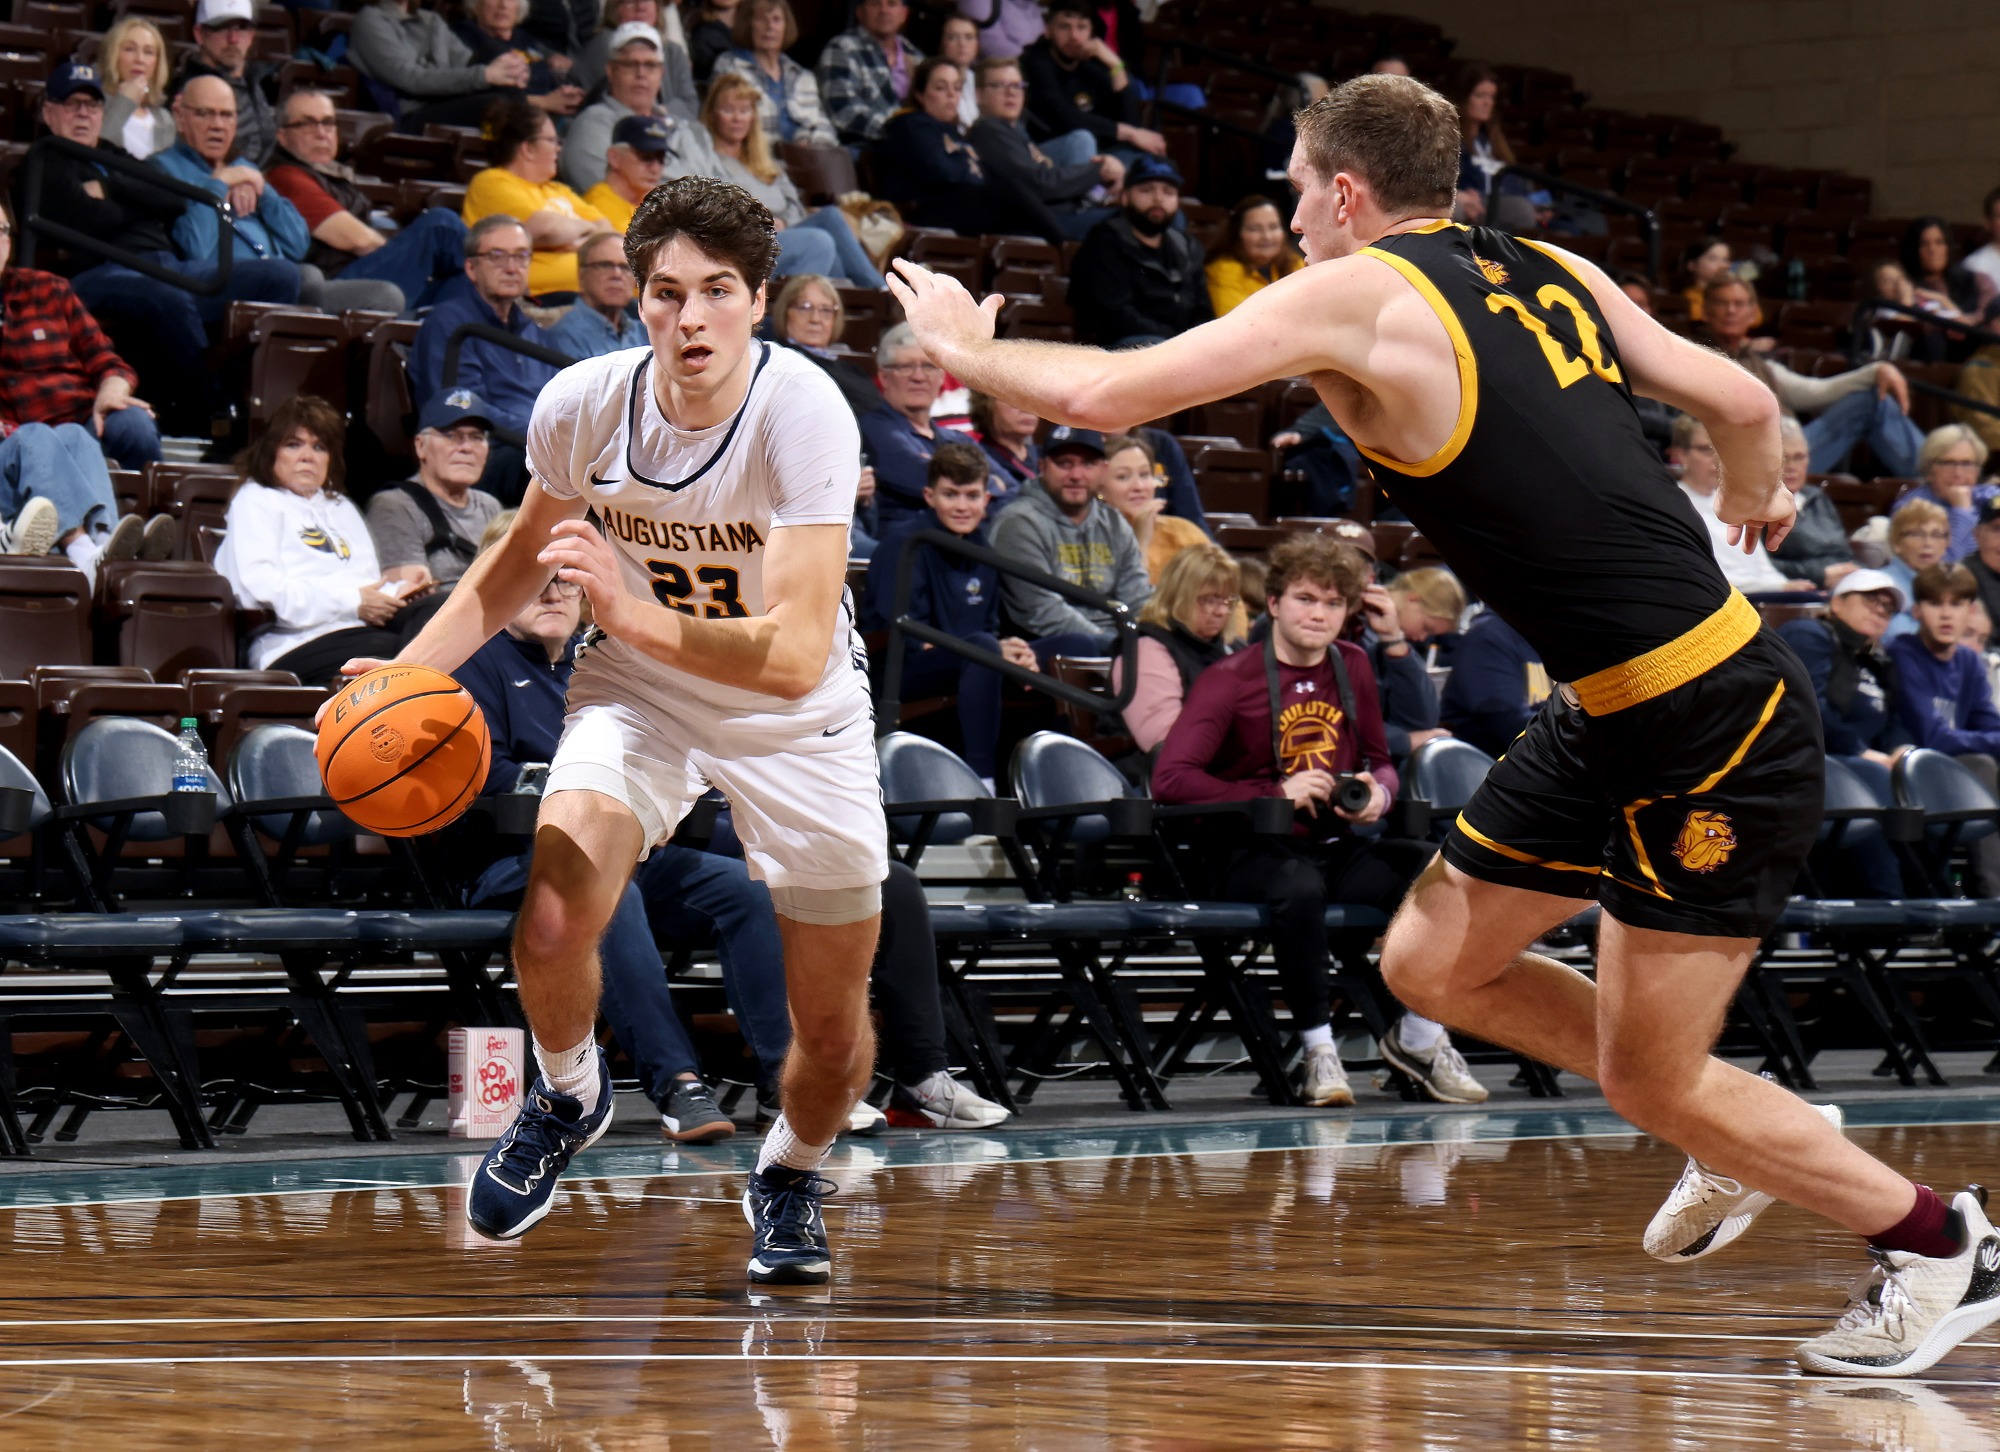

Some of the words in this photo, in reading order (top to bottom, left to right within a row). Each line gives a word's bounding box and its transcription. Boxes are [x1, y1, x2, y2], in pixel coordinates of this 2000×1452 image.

[1485, 284, 1622, 389] 22
[603, 505, 765, 553] AUGUSTANA
[644, 558, 752, 618] 23
[335, 675, 390, 724] EVO
[391, 671, 413, 679] NXT
[486, 1035, 508, 1056] fresh
[479, 1061, 507, 1087] POP
[482, 1077, 516, 1105] CORN
